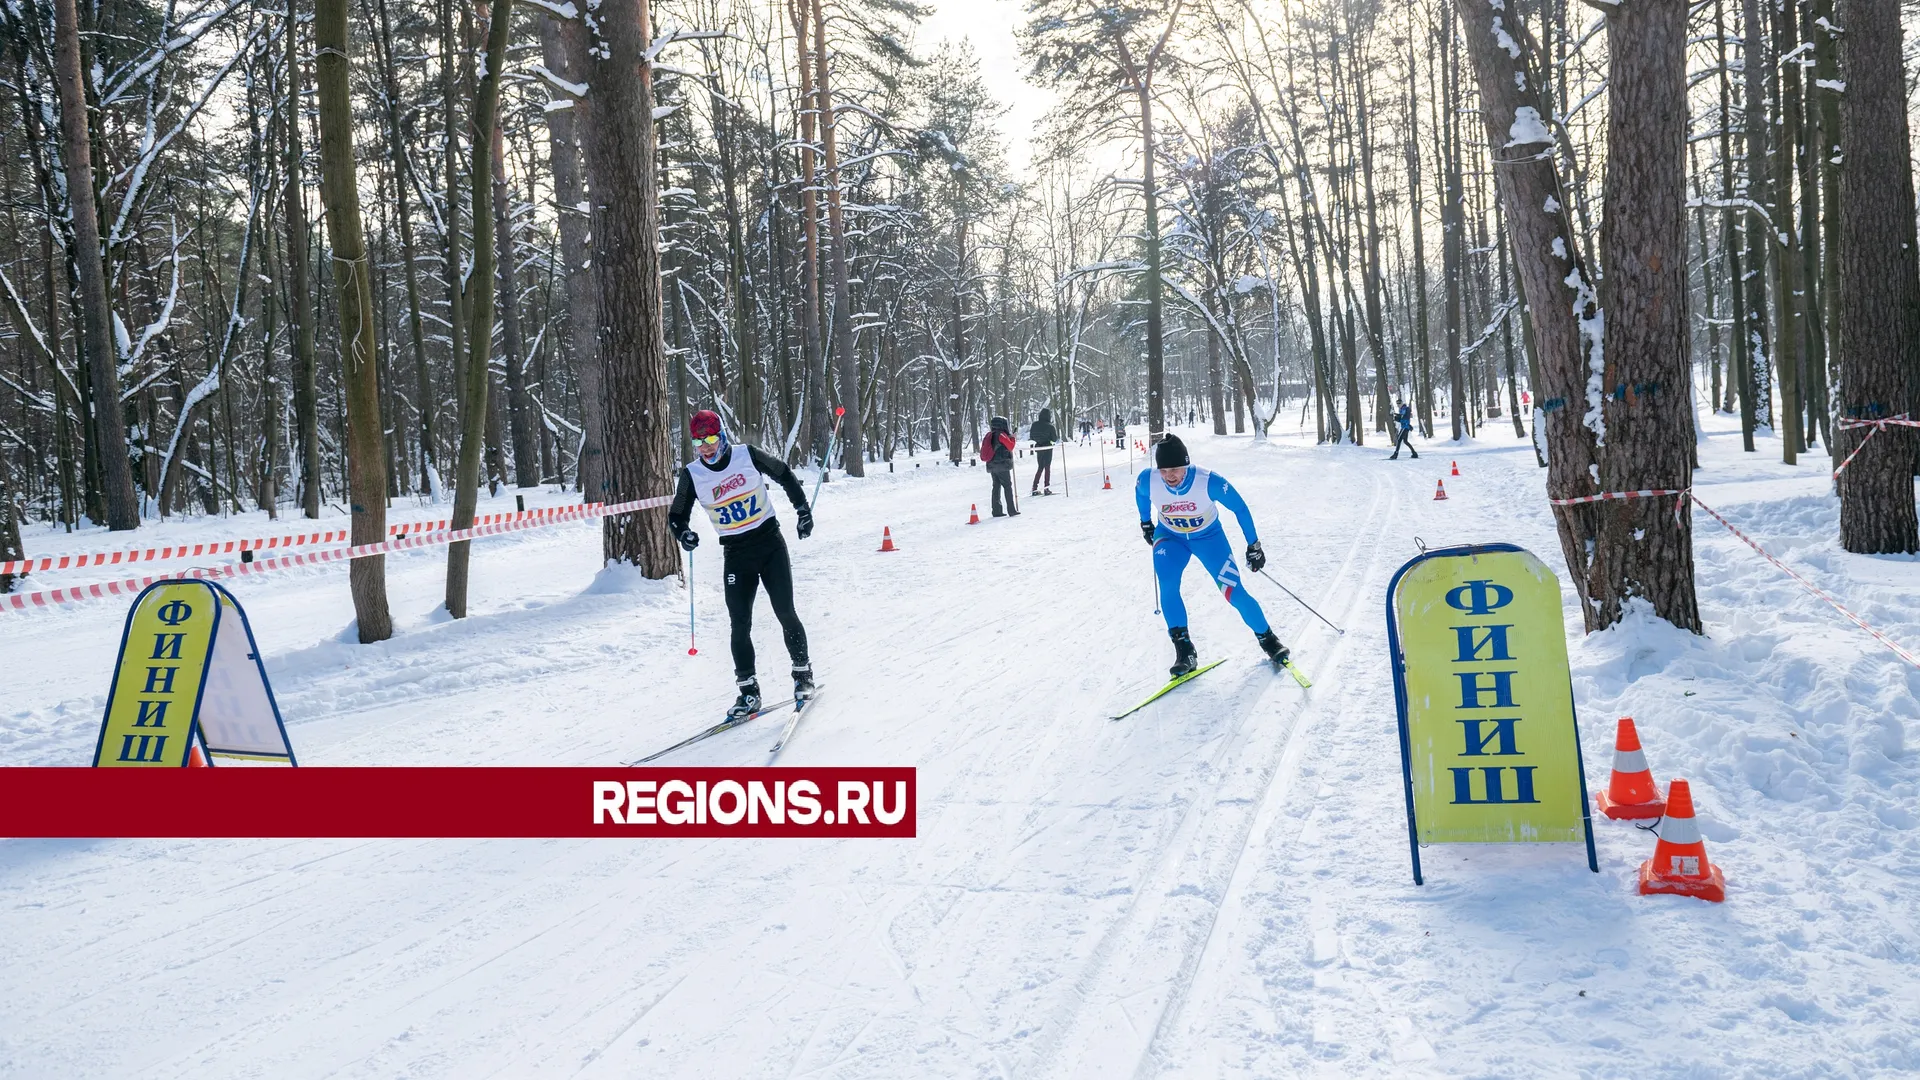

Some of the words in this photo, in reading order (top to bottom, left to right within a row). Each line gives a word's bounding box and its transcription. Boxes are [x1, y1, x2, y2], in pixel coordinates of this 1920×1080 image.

[714, 494, 762, 524] 382
[116, 600, 192, 762] ФИНИШ
[1445, 580, 1541, 804] ФИНИШ
